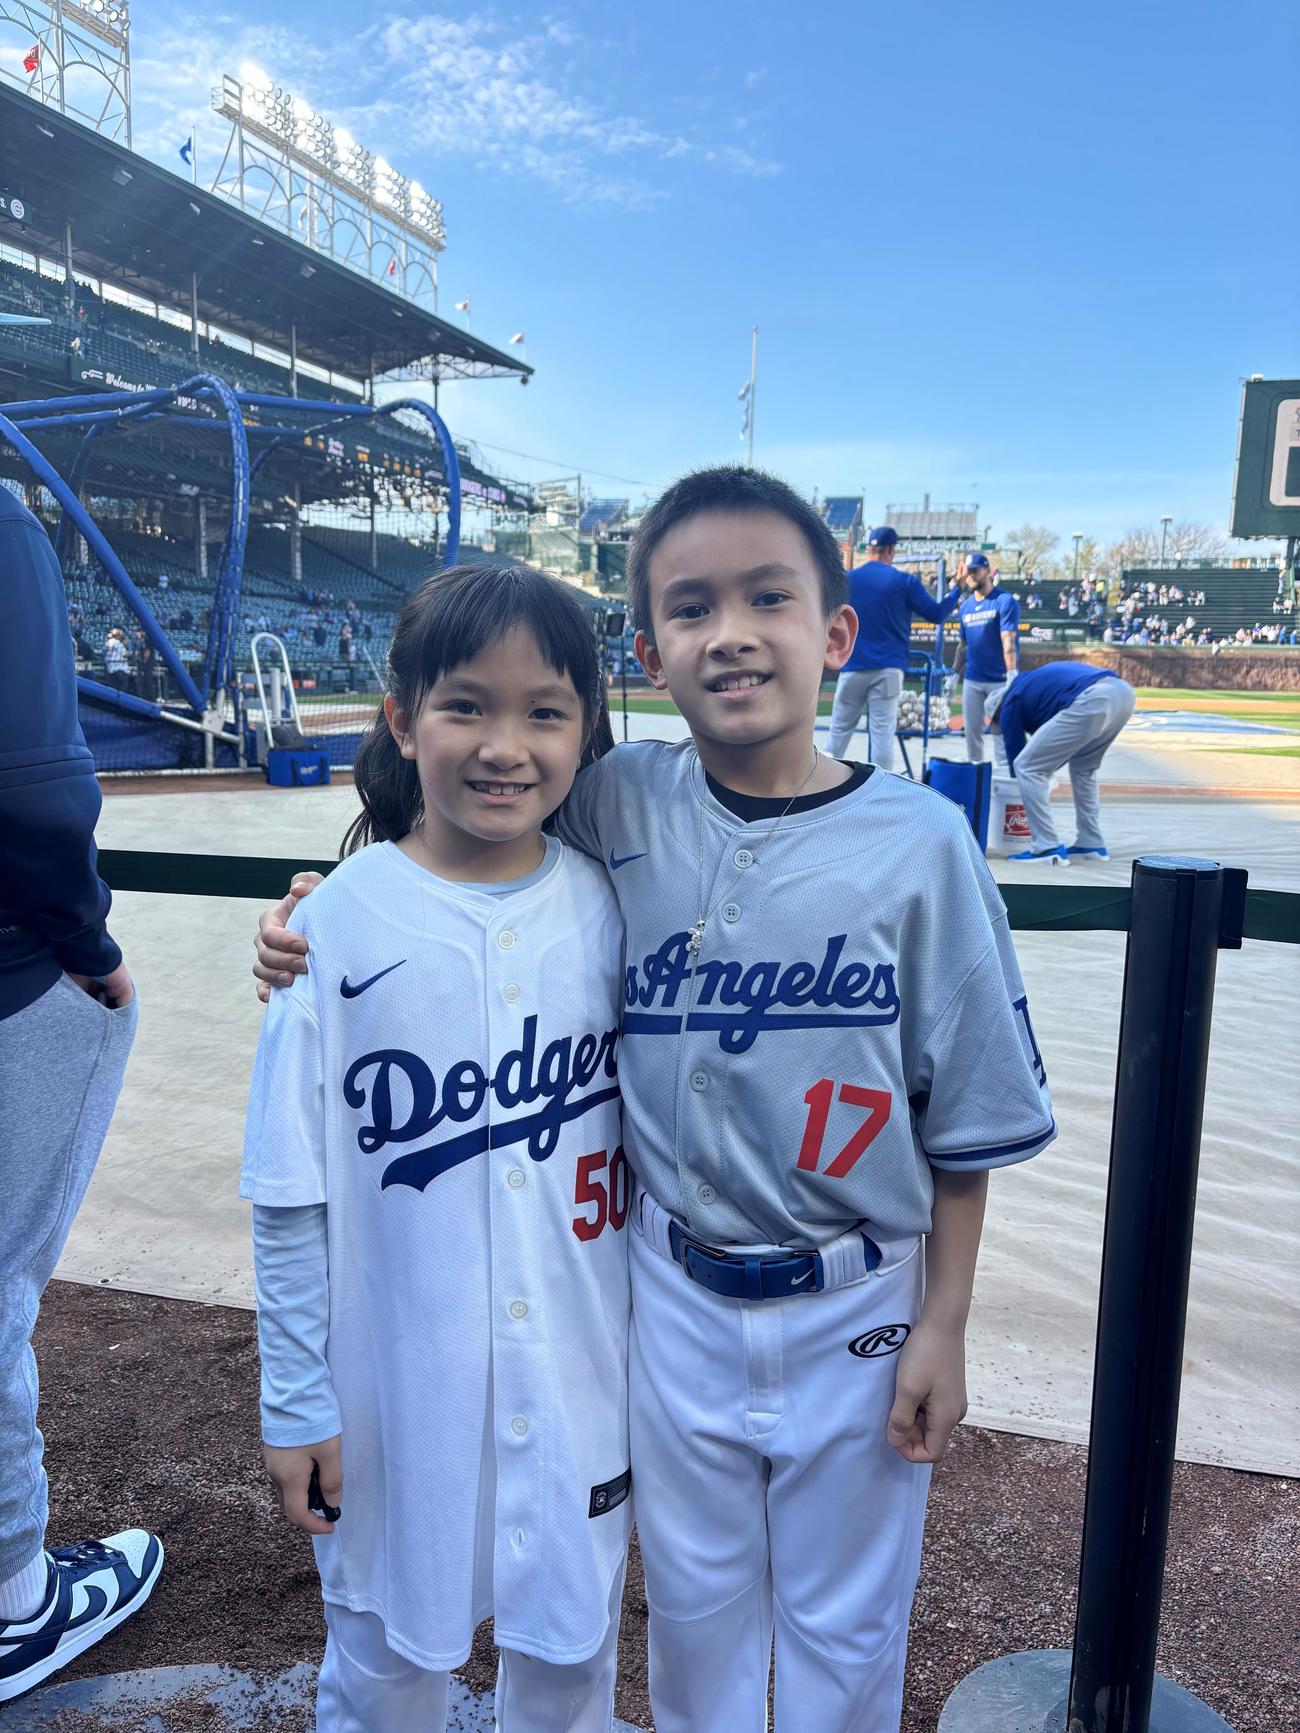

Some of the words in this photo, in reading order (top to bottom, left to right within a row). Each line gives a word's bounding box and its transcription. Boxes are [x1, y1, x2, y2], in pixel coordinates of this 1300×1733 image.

[638, 932, 901, 1054] Angeles
[343, 1014, 620, 1163] Dodger
[796, 1078, 892, 1179] 17
[572, 1146, 628, 1242] 50
